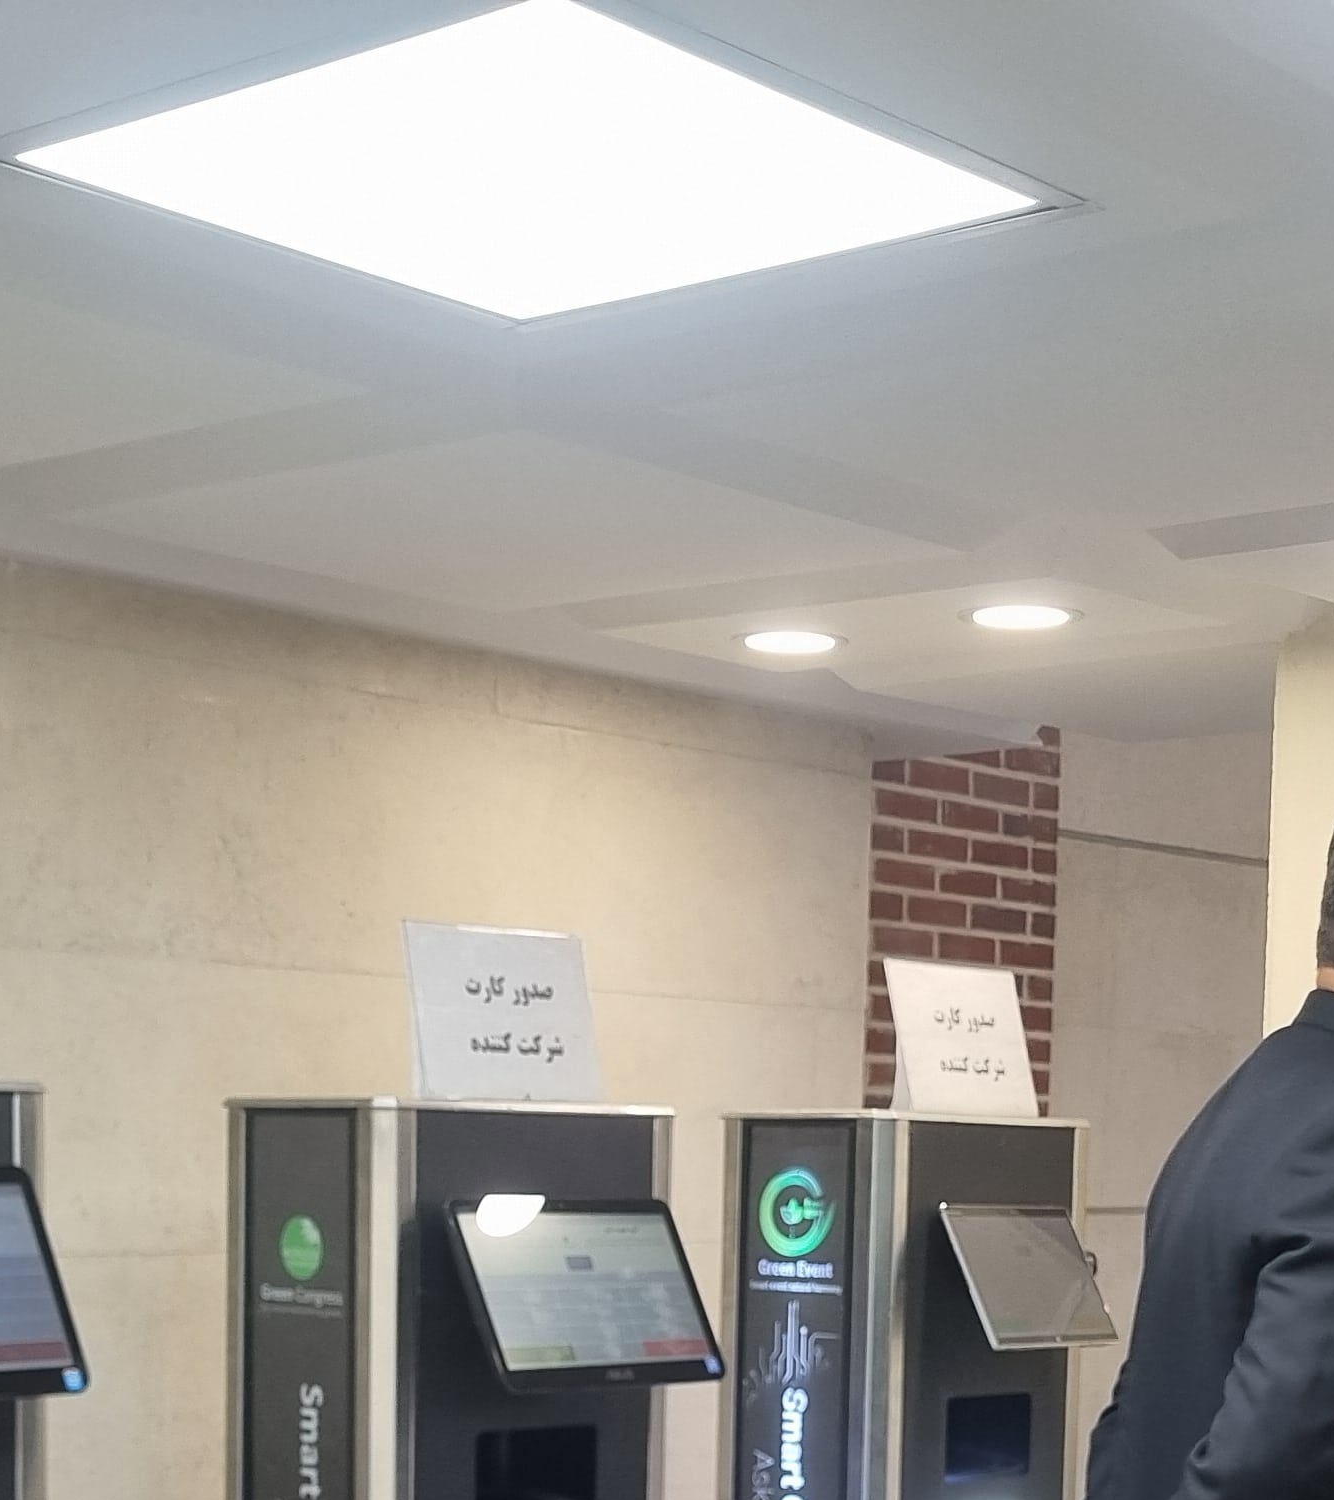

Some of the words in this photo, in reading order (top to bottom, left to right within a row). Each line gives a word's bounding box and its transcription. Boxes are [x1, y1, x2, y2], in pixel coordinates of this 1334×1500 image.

[465, 976, 505, 1003] کارت
[512, 983, 554, 1006] صدور
[470, 1032, 512, 1054] کننده
[517, 1034, 565, 1063] شرکت
[758, 1258, 795, 1277] Green
[796, 1260, 834, 1279] Event
[298, 1382, 324, 1500] Smart
[779, 1387, 809, 1491] Smart
